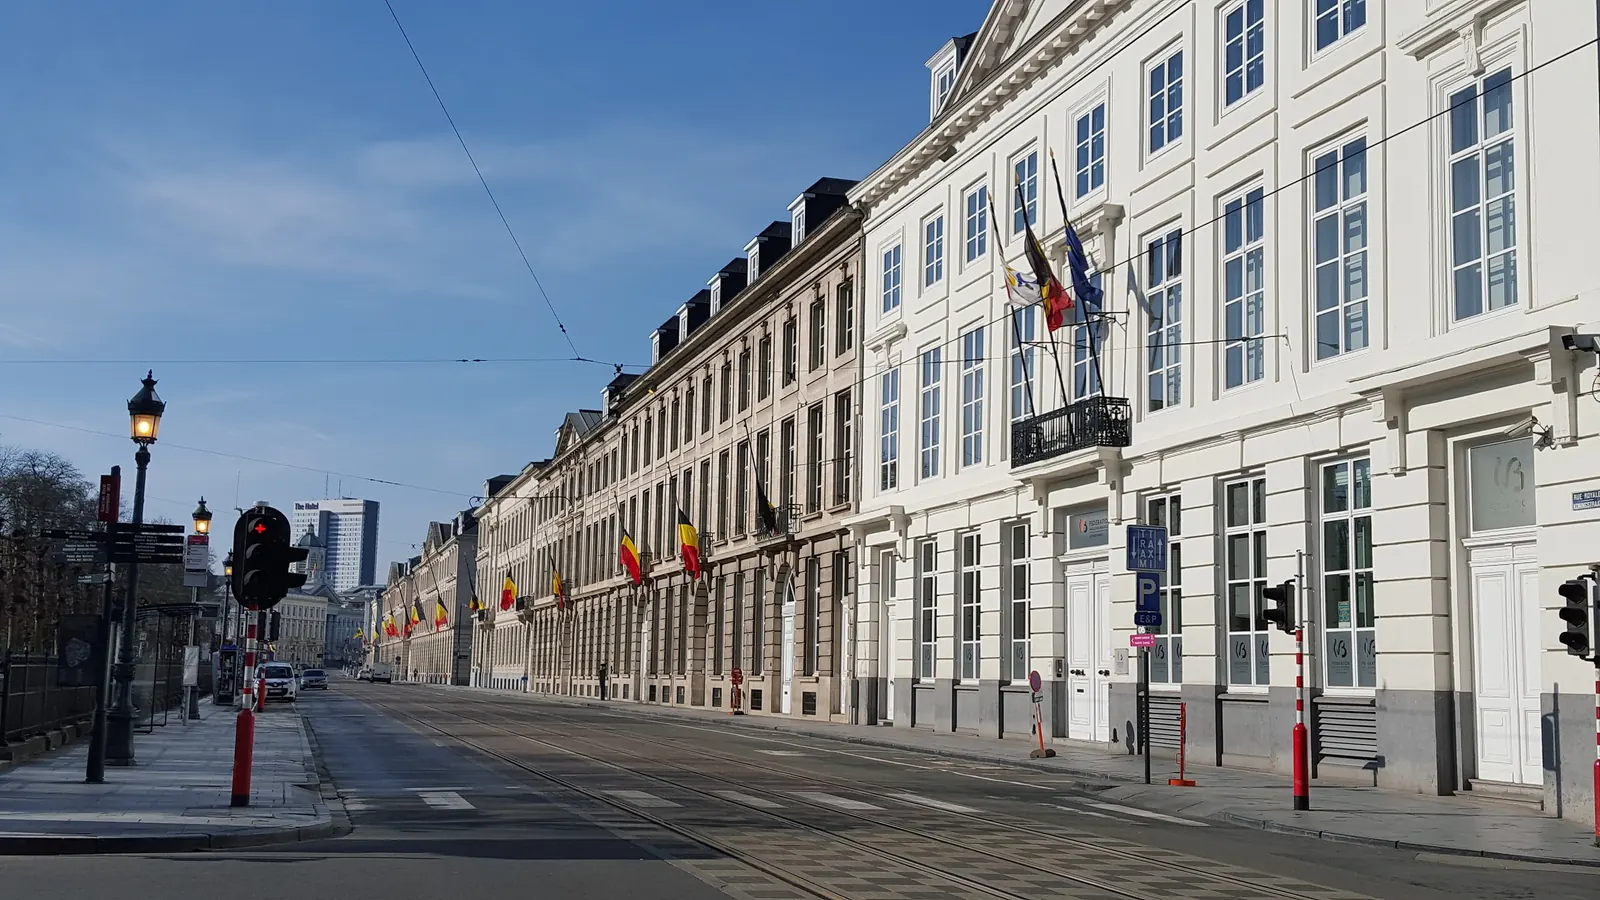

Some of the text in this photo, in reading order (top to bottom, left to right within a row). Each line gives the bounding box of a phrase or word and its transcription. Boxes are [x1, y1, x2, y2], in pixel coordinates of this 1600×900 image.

[1573, 493, 1583, 501] RUE
[295, 502, 319, 510] The Hotel
[1139, 578, 1156, 606] P
[1140, 614, 1157, 624] E&P
